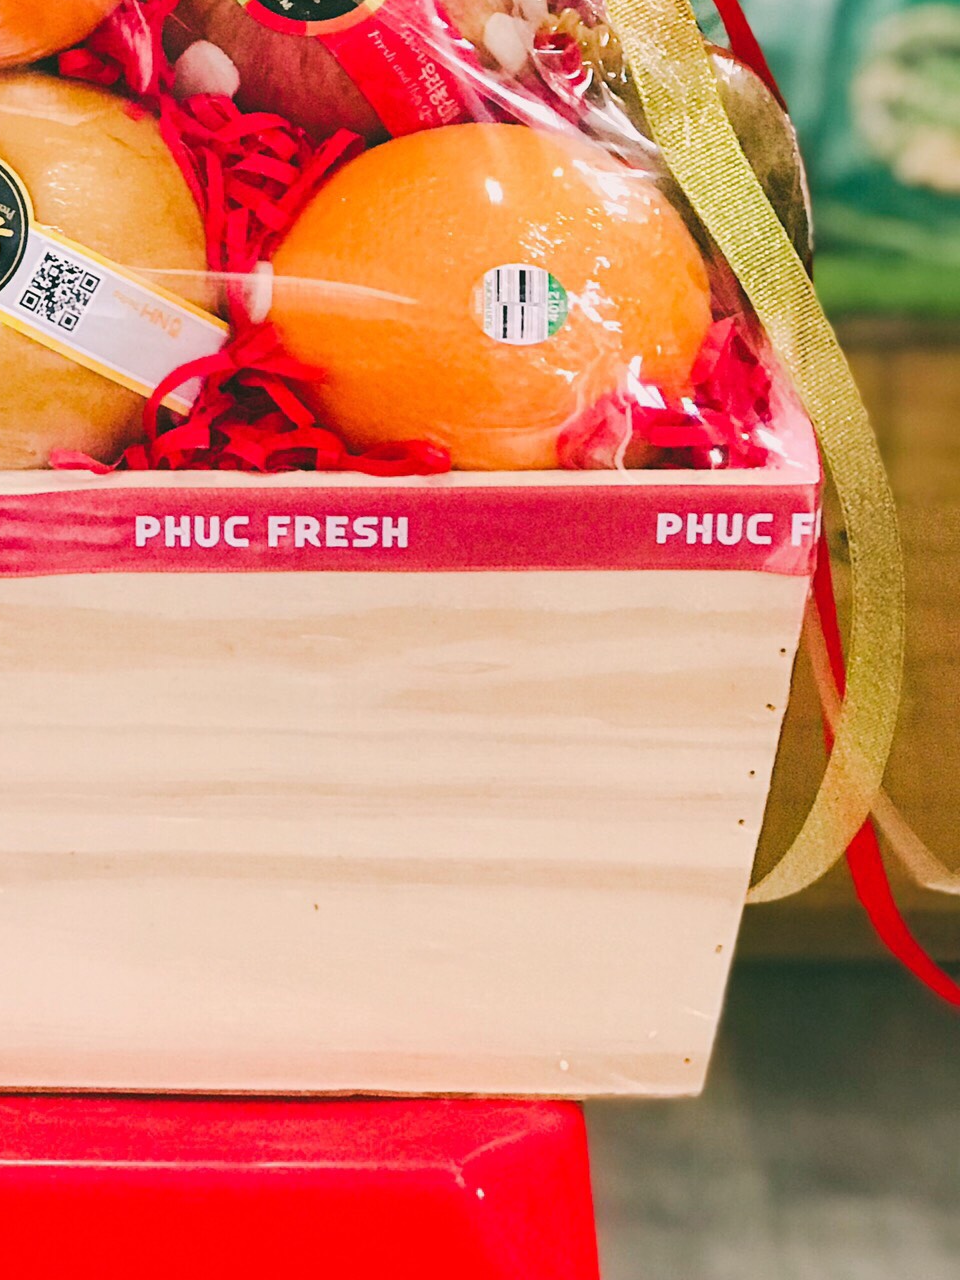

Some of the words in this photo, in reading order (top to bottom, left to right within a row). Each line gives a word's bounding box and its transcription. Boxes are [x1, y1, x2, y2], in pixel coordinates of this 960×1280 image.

[548, 291, 560, 320] 4012
[135, 515, 249, 548] PHUC
[267, 515, 408, 548] FRESH
[656, 513, 774, 545] PHUC
